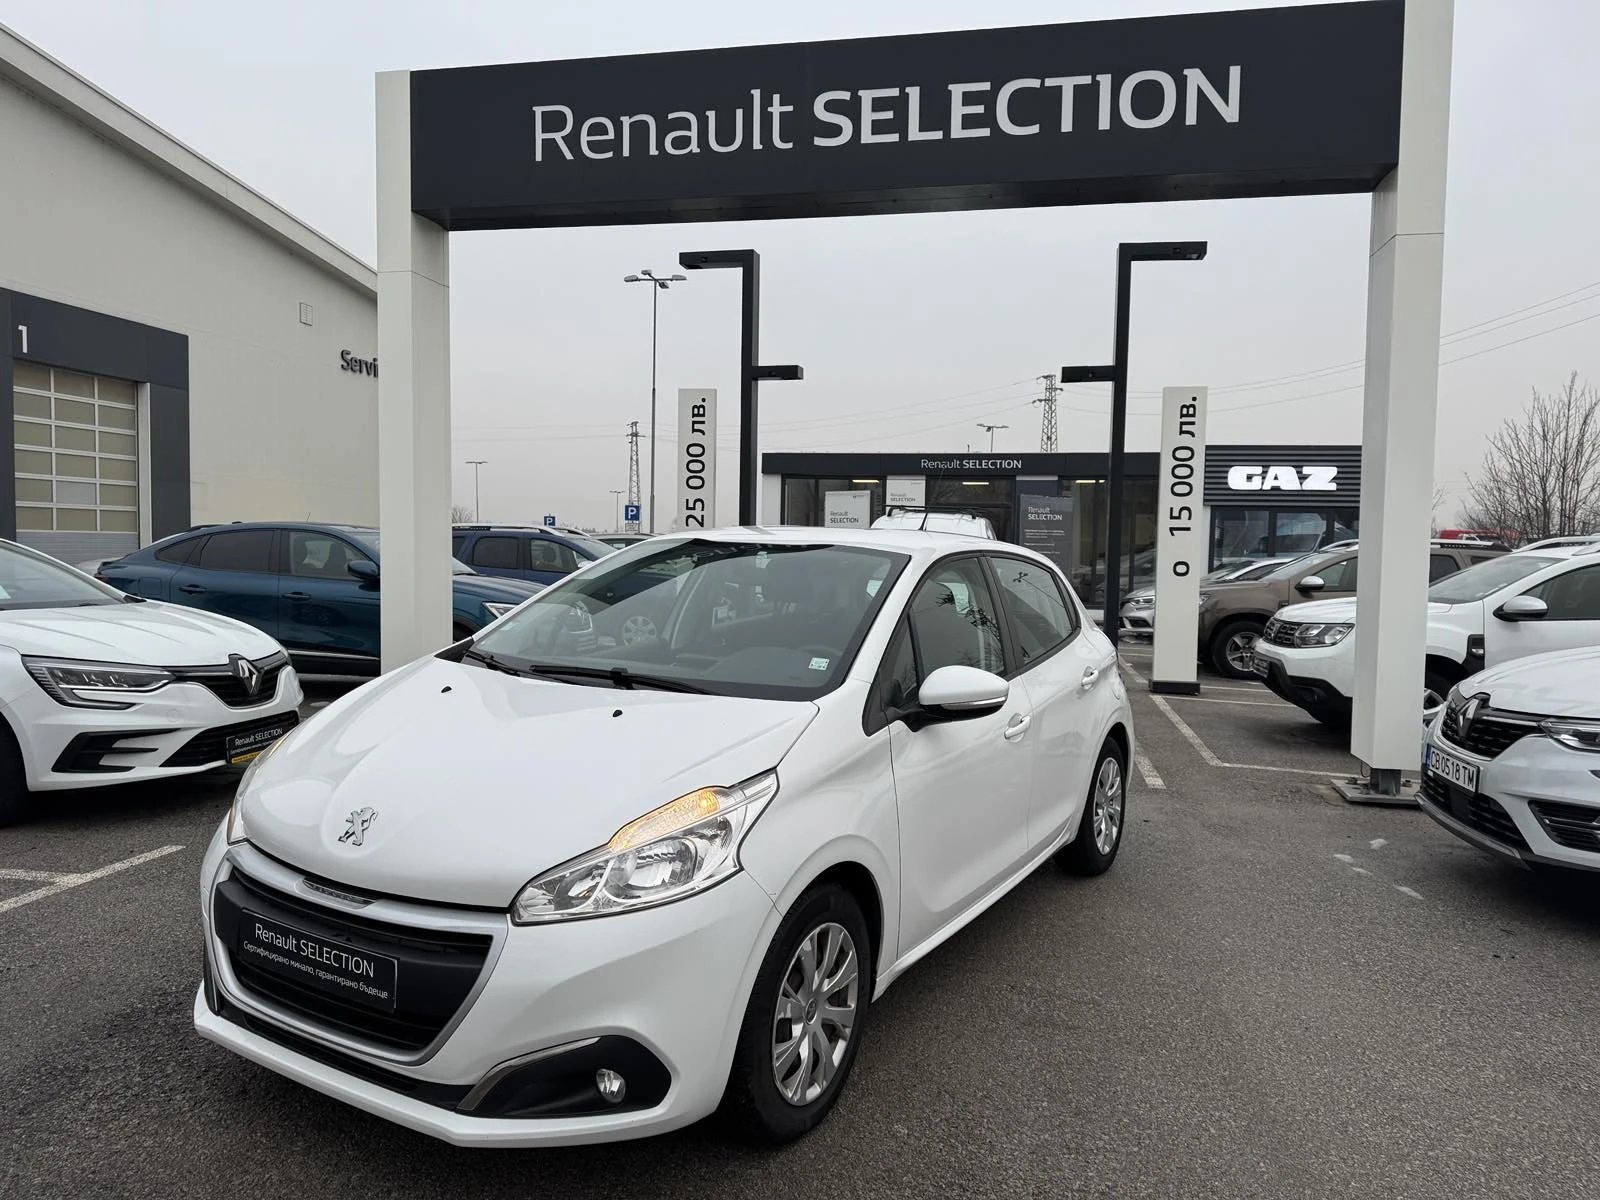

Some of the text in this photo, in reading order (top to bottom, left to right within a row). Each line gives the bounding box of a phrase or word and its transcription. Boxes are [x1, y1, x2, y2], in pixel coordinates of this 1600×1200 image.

[532, 65, 1242, 162] Renault SELECTION
[18, 324, 28, 354] 1
[340, 349, 378, 378] Servi
[1178, 396, 1198, 438] лв.
[685, 397, 706, 528] 25 000 лв.
[921, 459, 1022, 469] Renault SELECTION
[1170, 445, 1195, 498] 000
[1227, 466, 1338, 491] GAZ
[628, 507, 637, 519] P
[1027, 513, 1063, 521] SELECTION
[1028, 506, 1051, 514] Renault
[1168, 506, 1193, 537] 15
[234, 727, 283, 746] Renault SELECTION
[1440, 755, 1461, 781] 0518
[255, 922, 374, 978] Renault SELECTION
[243, 940, 388, 999] Сертифицирано минало, гарантирано бъдеще
